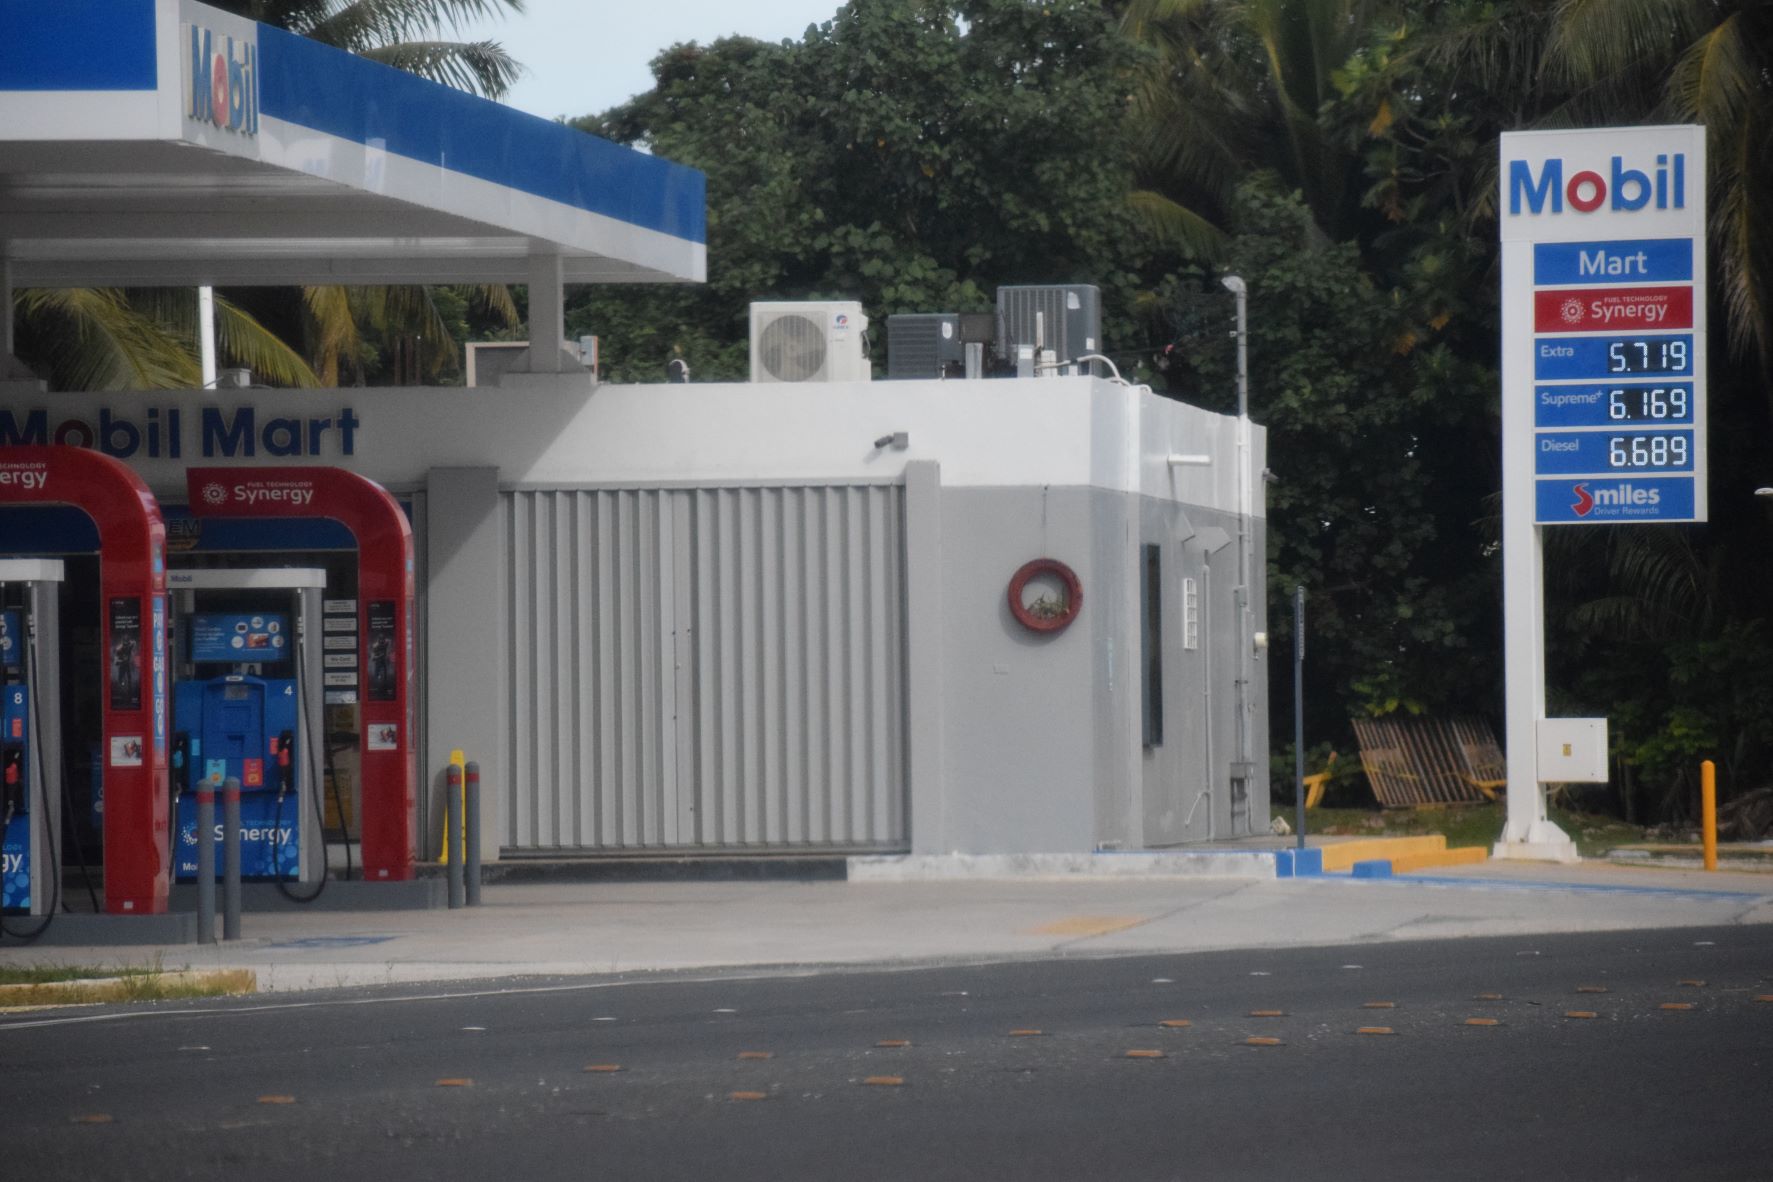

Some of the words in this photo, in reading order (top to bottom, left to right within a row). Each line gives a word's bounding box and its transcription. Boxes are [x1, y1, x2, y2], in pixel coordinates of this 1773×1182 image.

[188, 24, 258, 136] Mobil
[1509, 153, 1685, 215] Mobil
[1579, 250, 1648, 276] Mart
[1591, 301, 1668, 323] Synergy
[1540, 344, 1575, 358] Extra
[1610, 341, 1687, 372] 5.719
[1609, 388, 1687, 420] 6.169
[0, 407, 181, 459] Mobil
[201, 407, 360, 457] Mart
[1541, 439, 1580, 452] Diesel
[1609, 436, 1687, 467] 6.689
[233, 485, 314, 505] Synergy
[1594, 507, 1620, 516] Driver
[1621, 505, 1660, 516] Rewards
[14, 692, 23, 704] 8
[284, 685, 294, 697] 4
[213, 824, 292, 846] Snergy
